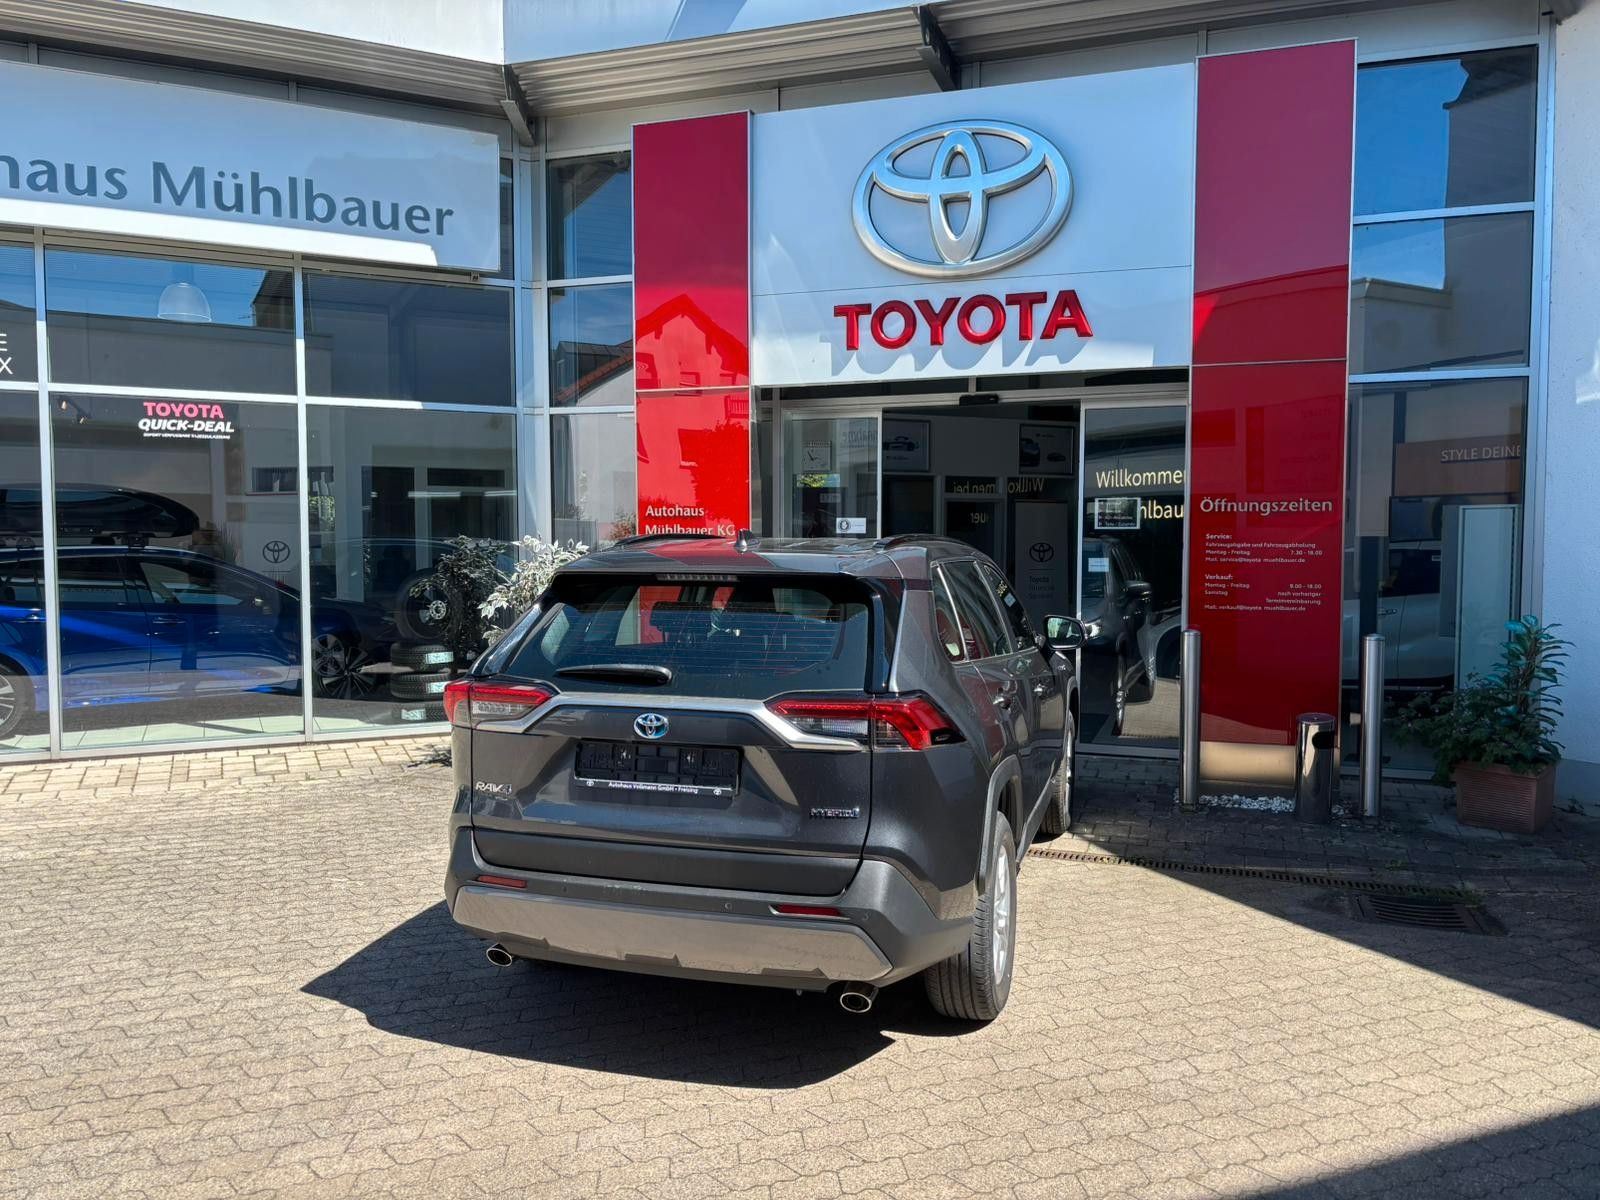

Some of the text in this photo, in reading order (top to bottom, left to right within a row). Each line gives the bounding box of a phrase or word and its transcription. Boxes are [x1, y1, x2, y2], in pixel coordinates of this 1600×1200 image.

[152, 160, 454, 236] Mühlbauer
[833, 289, 1094, 351] TOYOTA
[143, 401, 224, 419] TOYOTA
[138, 418, 235, 433] QUICK-DEAL
[1441, 447, 1478, 462] STYLE
[1096, 468, 1185, 489] Willkomme
[645, 504, 705, 517] Autohaus
[1200, 496, 1333, 516] Öffnungszeiten
[645, 523, 736, 537] Mühlbauer KG
[475, 781, 513, 795] RAV4
